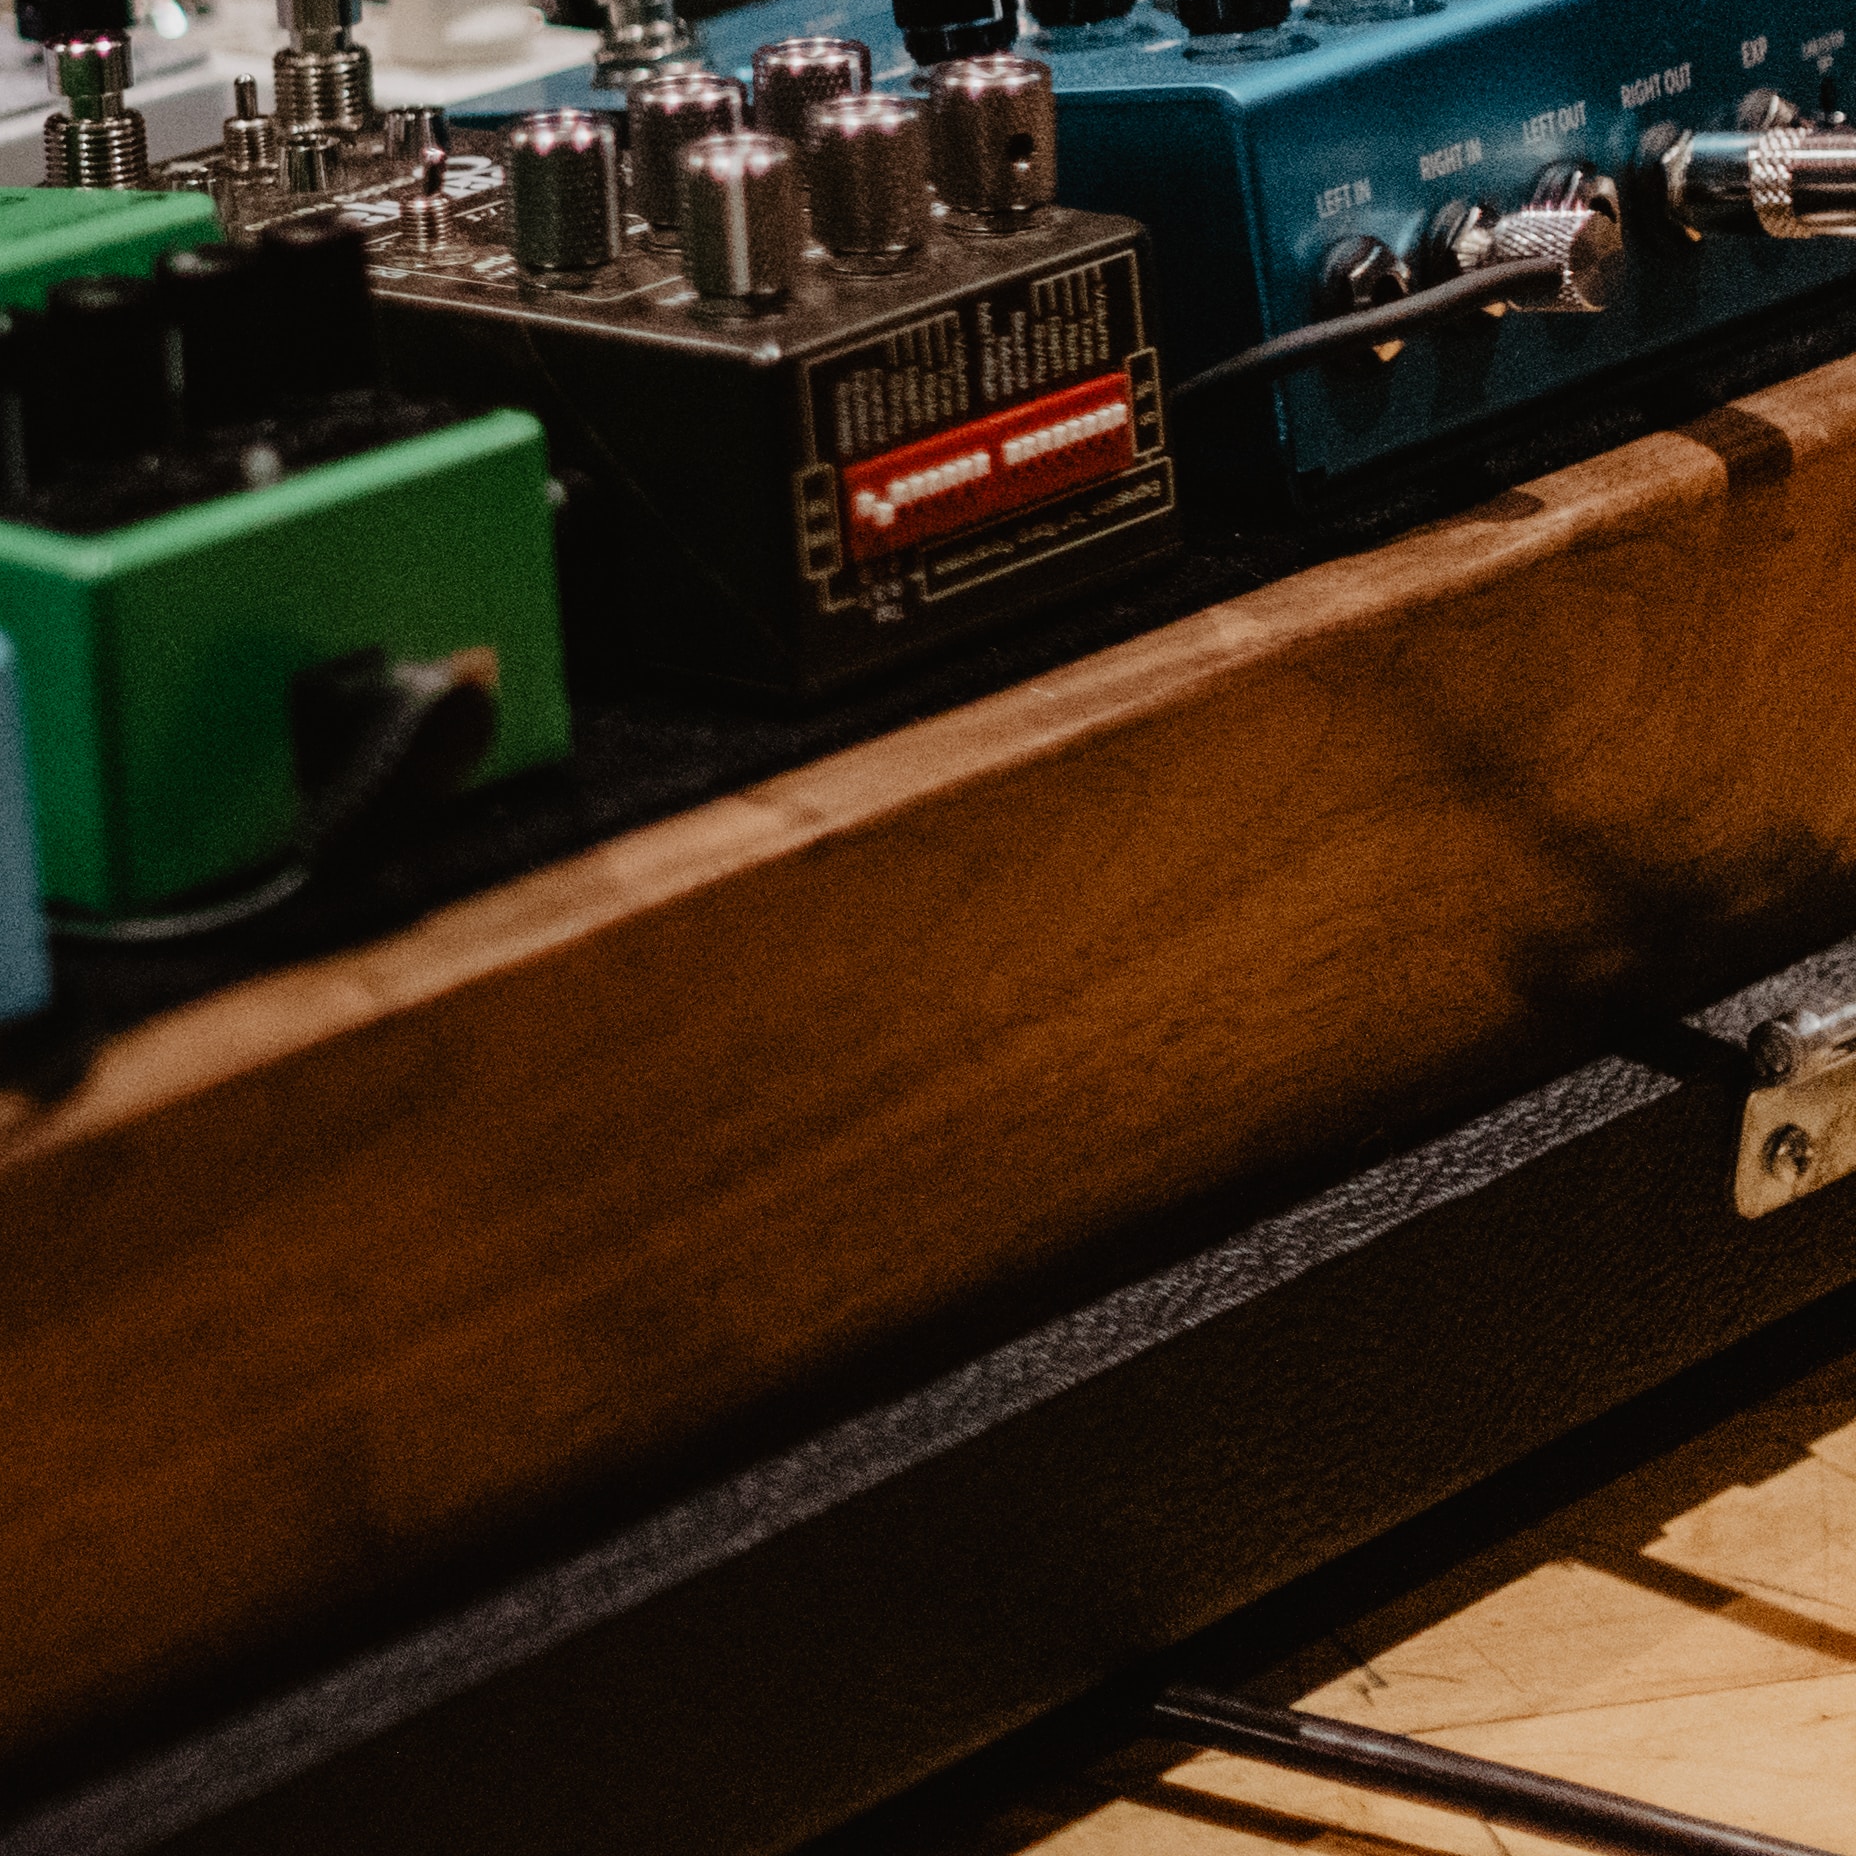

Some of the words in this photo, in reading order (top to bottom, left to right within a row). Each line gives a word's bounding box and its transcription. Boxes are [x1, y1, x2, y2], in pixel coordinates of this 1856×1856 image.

[1741, 35, 1768, 69] EXP
[1621, 74, 1661, 109] RIGHT
[1664, 62, 1691, 94] OUT
[1523, 110, 1555, 145] LEFT
[1557, 100, 1586, 133] OUT
[1419, 144, 1463, 181] RIGHT
[1464, 136, 1483, 165] IN
[1315, 183, 1351, 219] LEFT
[1353, 176, 1372, 206] IN
